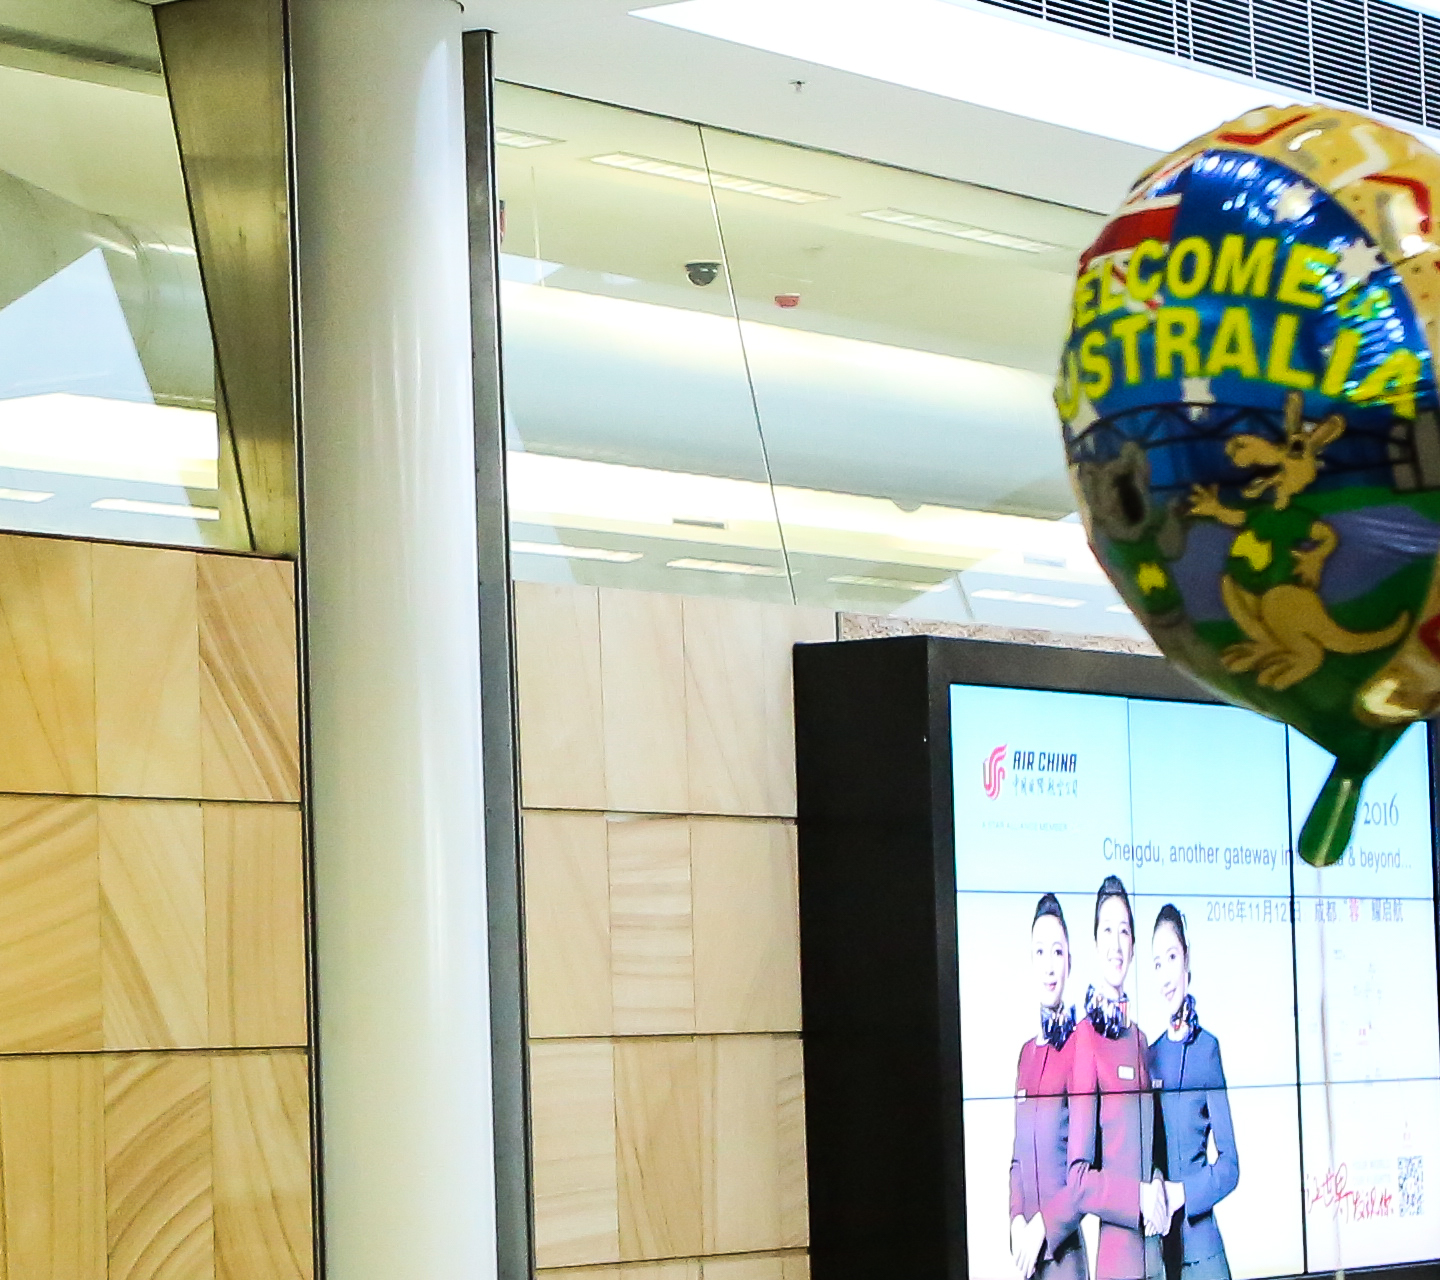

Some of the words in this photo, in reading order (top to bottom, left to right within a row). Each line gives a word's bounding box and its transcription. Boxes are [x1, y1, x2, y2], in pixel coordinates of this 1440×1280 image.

[1072, 233, 1340, 329] ELCOME
[1058, 306, 1424, 420] USTRALIA
[1012, 750, 1036, 771] AIR
[1038, 751, 1078, 774] CHINA
[1363, 793, 1400, 826] 2016
[1169, 842, 1220, 865] another
[1223, 845, 1278, 871] gateway
